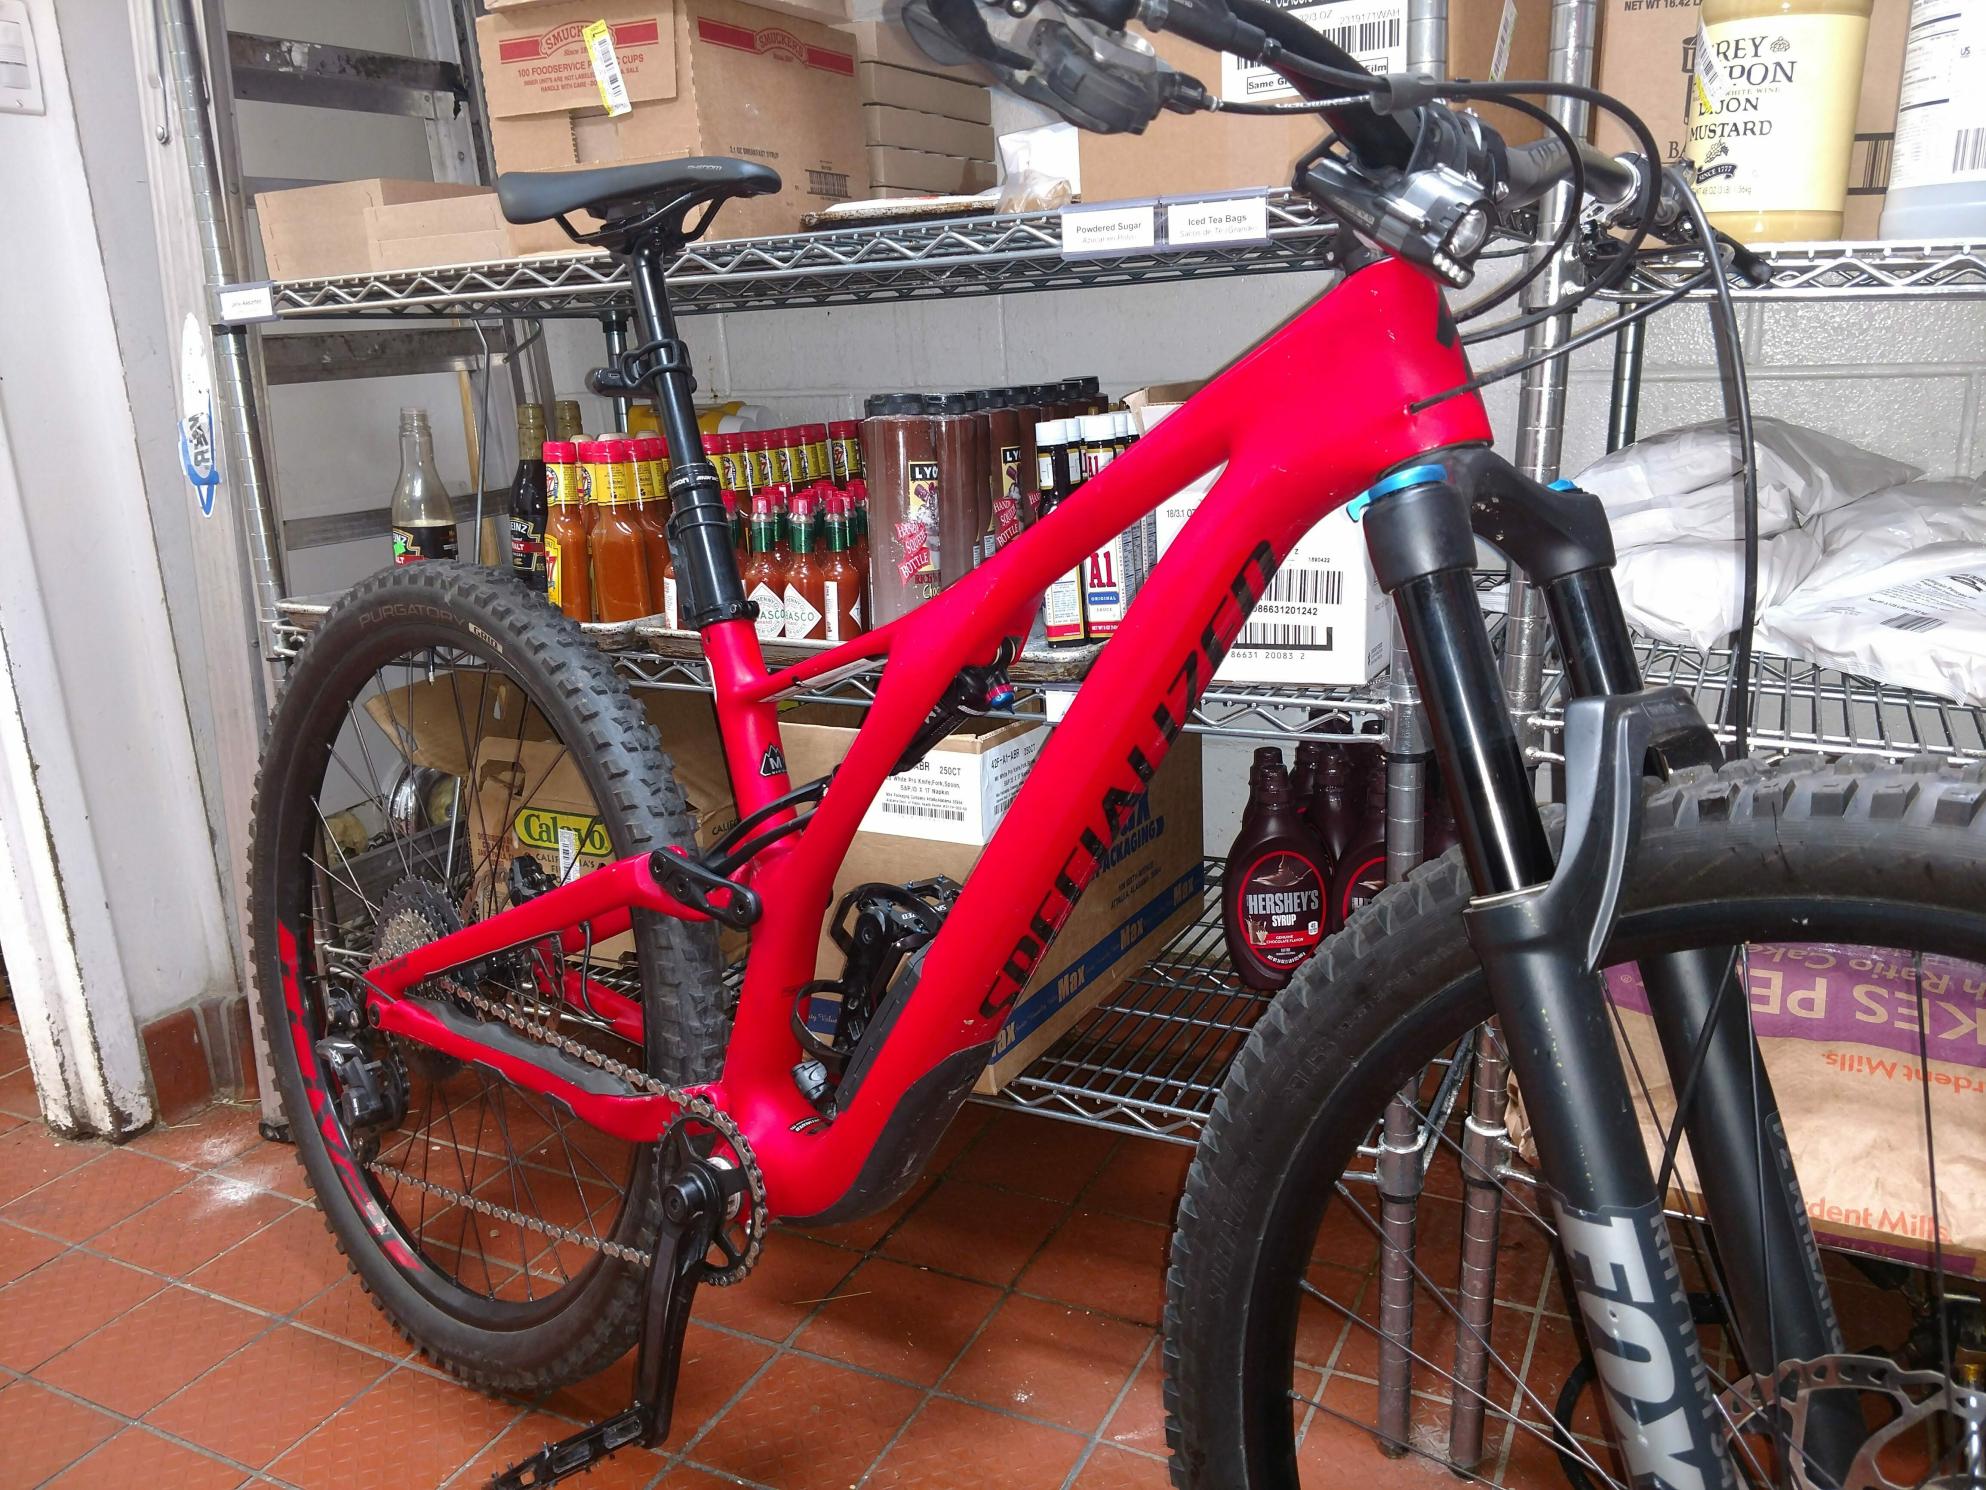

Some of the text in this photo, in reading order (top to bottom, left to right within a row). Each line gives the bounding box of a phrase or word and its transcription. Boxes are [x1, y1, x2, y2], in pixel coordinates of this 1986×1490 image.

[1712, 36, 1768, 62] REY
[532, 63, 585, 76] FOODSERVICE
[1689, 120, 1773, 142] MUSTARD
[1076, 221, 1142, 234] Powdered Sugar
[1188, 214, 1247, 226] Iced Tea Bags
[914, 465, 938, 479] LYO
[510, 519, 527, 534] EINZ
[900, 550, 929, 578] BOTTLE
[359, 603, 466, 629] PURGATORY
[1230, 650, 1258, 659] 86631
[1265, 651, 1293, 660] 20083
[523, 813, 605, 850] Calvo
[1095, 820, 1158, 879] ACKAGING
[1246, 889, 1319, 915] HERSHEY'S
[1120, 917, 1145, 950] Max
[1271, 914, 1297, 927] SYRUP
[1057, 965, 1086, 1003] Max
[1806, 1198, 1873, 1230] dent
[1552, 1204, 1705, 1490] FOX
